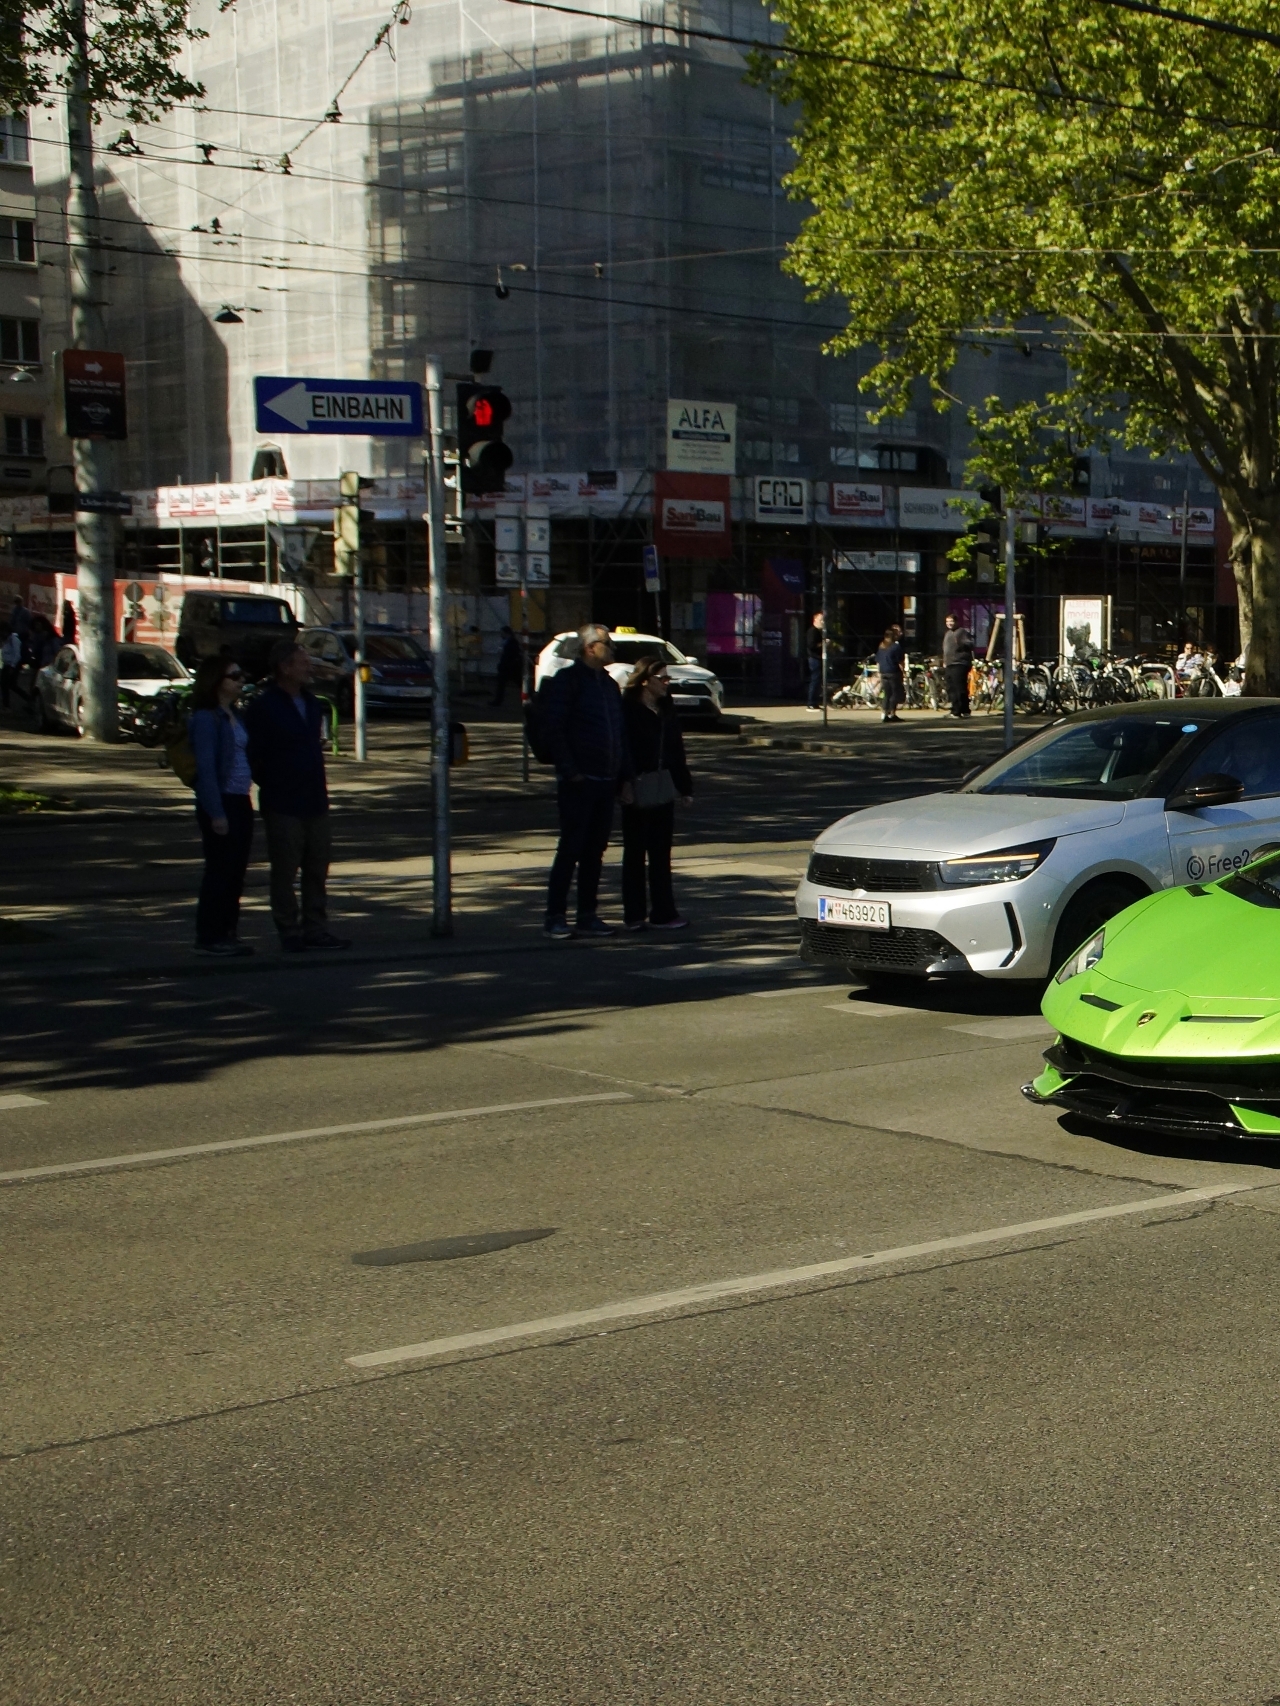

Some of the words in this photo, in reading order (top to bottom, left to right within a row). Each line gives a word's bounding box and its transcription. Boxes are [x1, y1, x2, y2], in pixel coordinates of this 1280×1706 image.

[311, 394, 404, 420] EINBAHN
[678, 406, 725, 431] ALFA
[758, 480, 804, 506] CAD
[837, 487, 880, 504] SaniBau
[666, 505, 721, 523] SaniBau
[1091, 502, 1131, 517] SaniBau
[1067, 609, 1099, 619] modern
[828, 902, 834, 919] W
[841, 903, 876, 922] 46392
